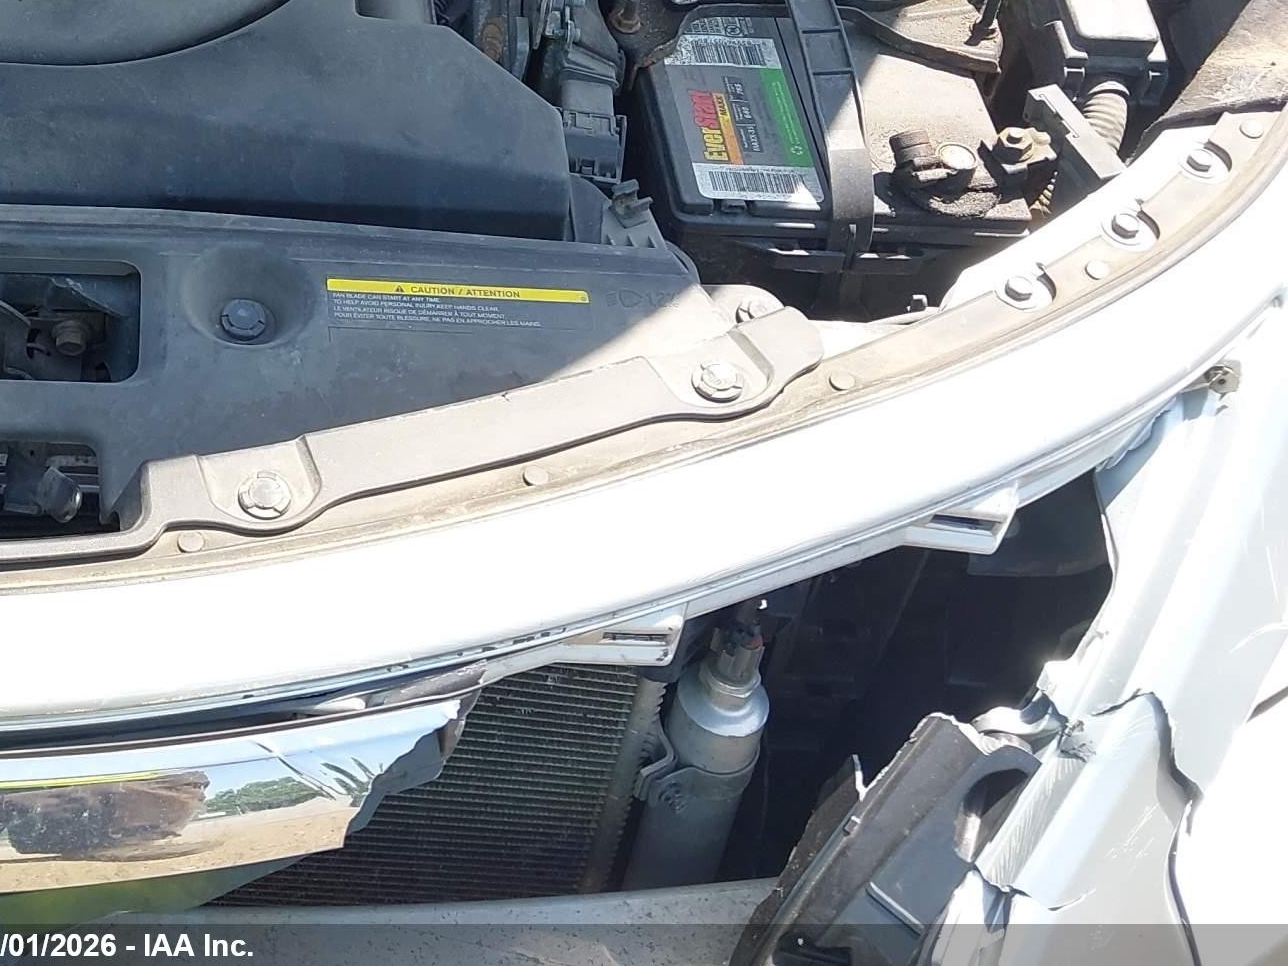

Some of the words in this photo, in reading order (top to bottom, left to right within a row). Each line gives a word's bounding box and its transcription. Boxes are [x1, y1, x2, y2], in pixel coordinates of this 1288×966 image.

[715, 95, 729, 116] MAXX
[689, 90, 730, 162] EverStart
[411, 286, 455, 295] CAUTION
[466, 289, 520, 298] ATTENTION
